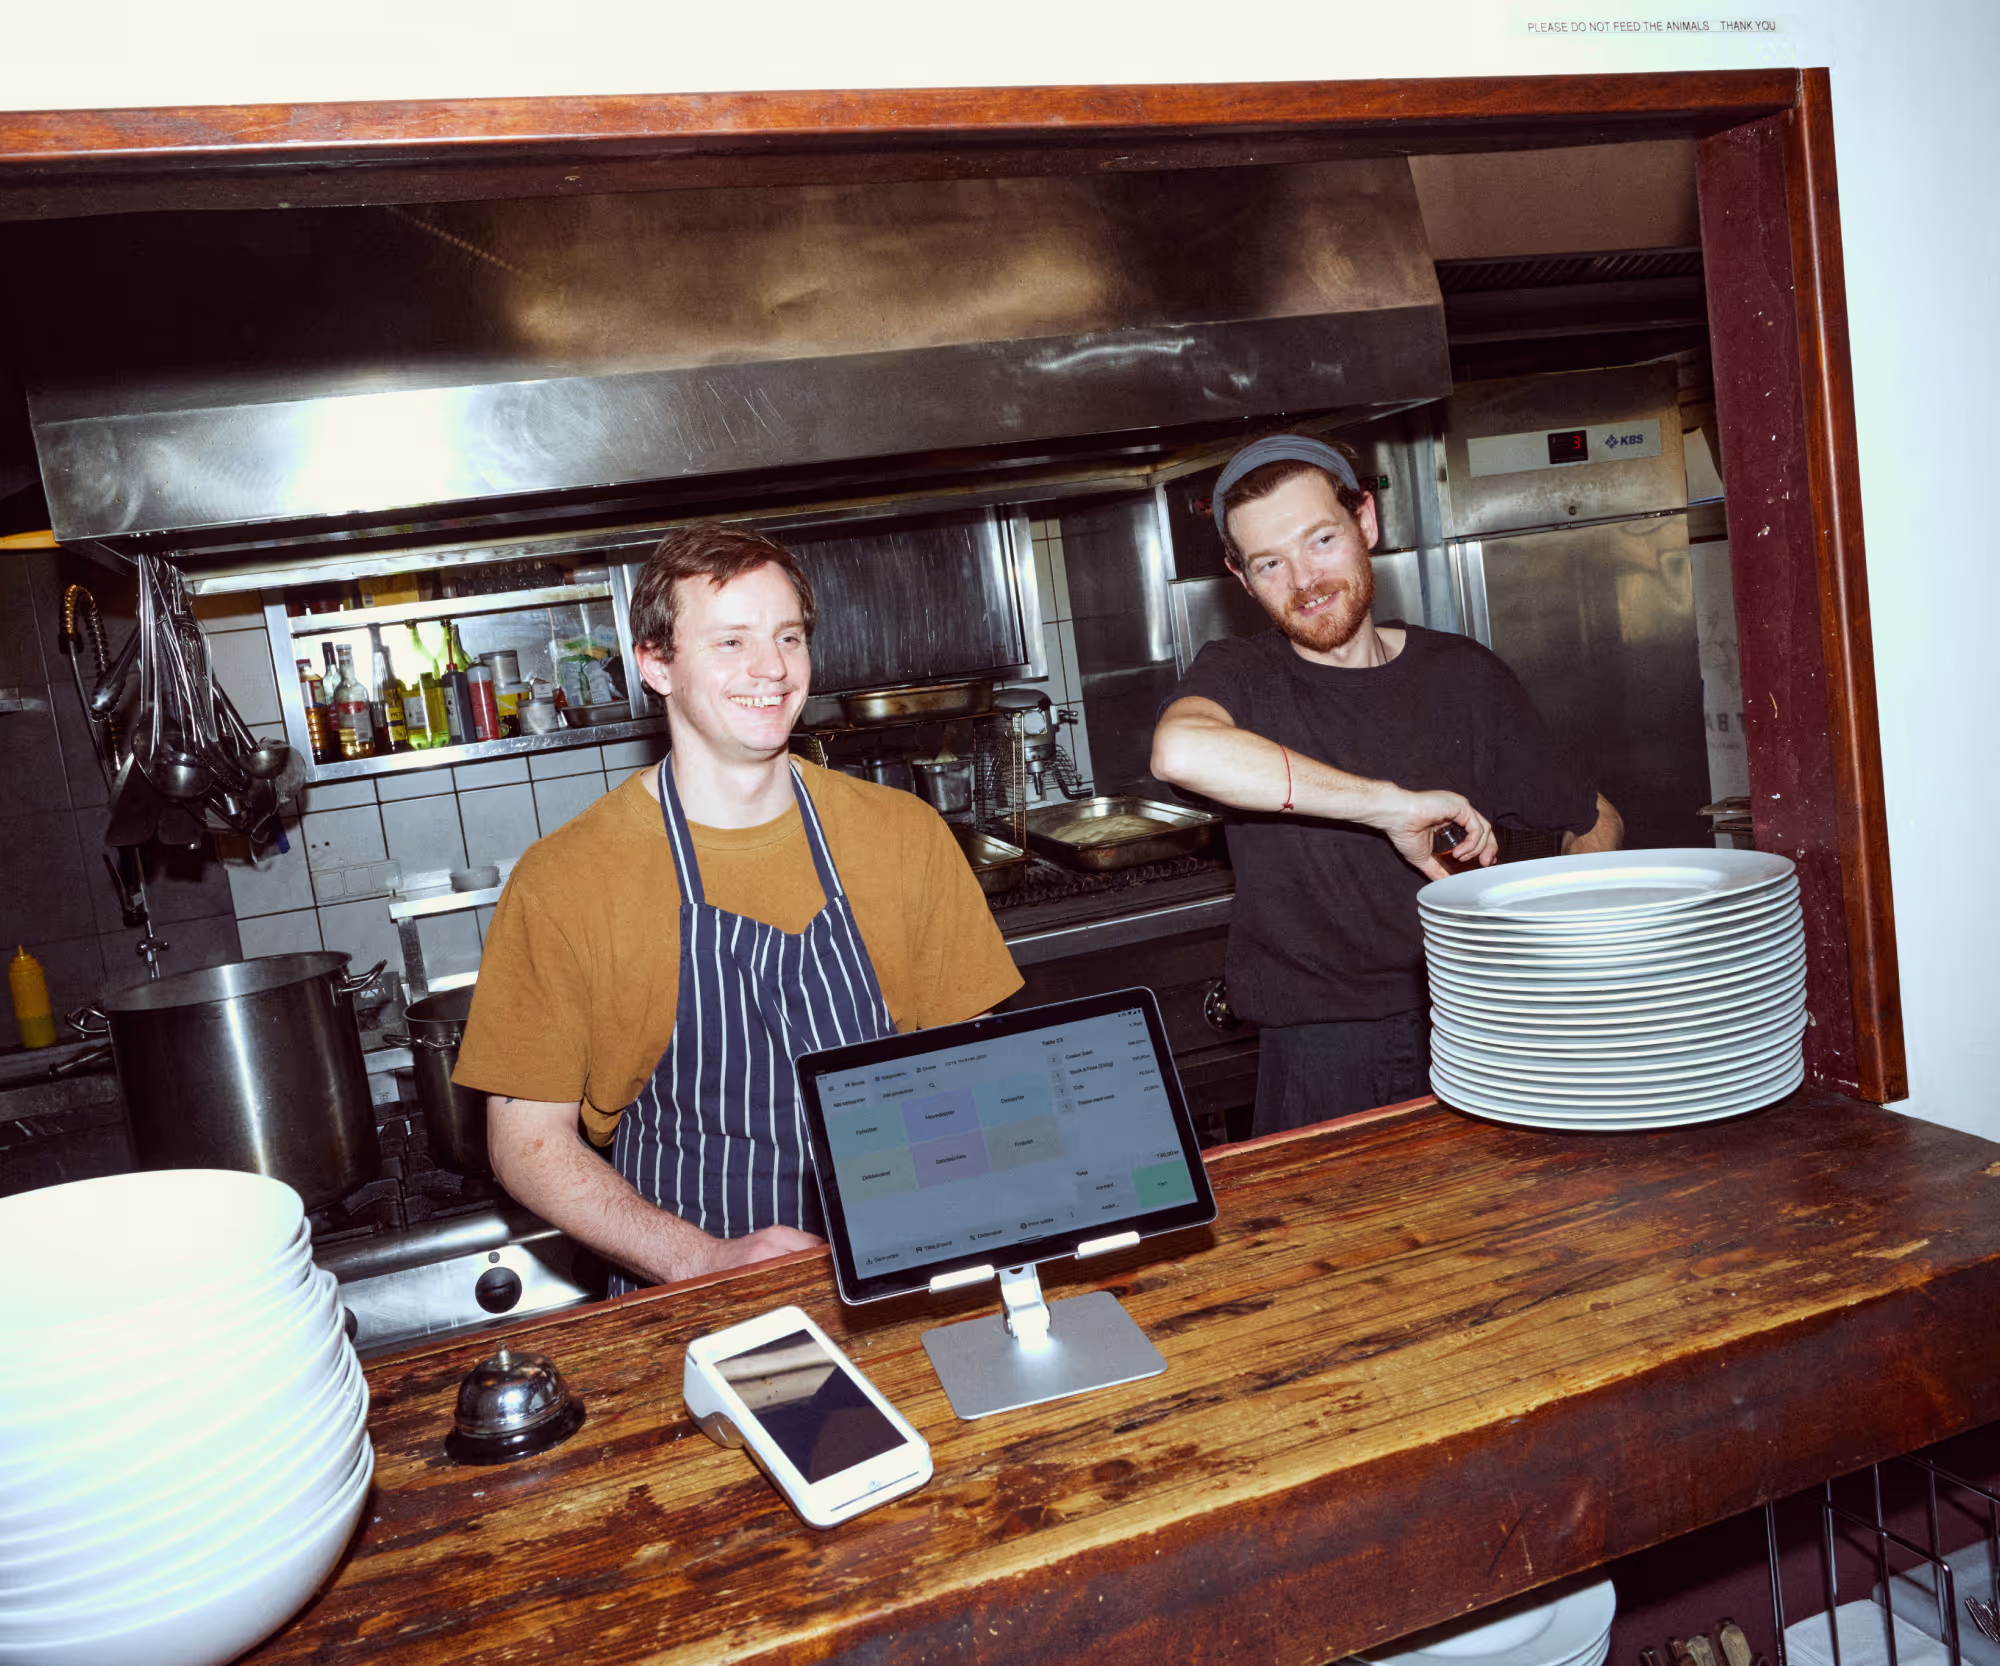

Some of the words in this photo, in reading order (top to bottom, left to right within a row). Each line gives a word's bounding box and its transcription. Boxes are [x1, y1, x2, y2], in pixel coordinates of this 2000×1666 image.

[1528, 22, 1567, 32] PLEASE
[1571, 22, 1586, 32] DO
[1589, 21, 1610, 32] NOT
[1613, 21, 1641, 32] FEED
[1643, 21, 1663, 32] THE
[1666, 20, 1710, 31] ANIMALS
[1720, 20, 1754, 31] THANK
[1755, 20, 1776, 31] YOU
[1574, 435, 1580, 449] 3
[1620, 434, 1643, 445] KBS
